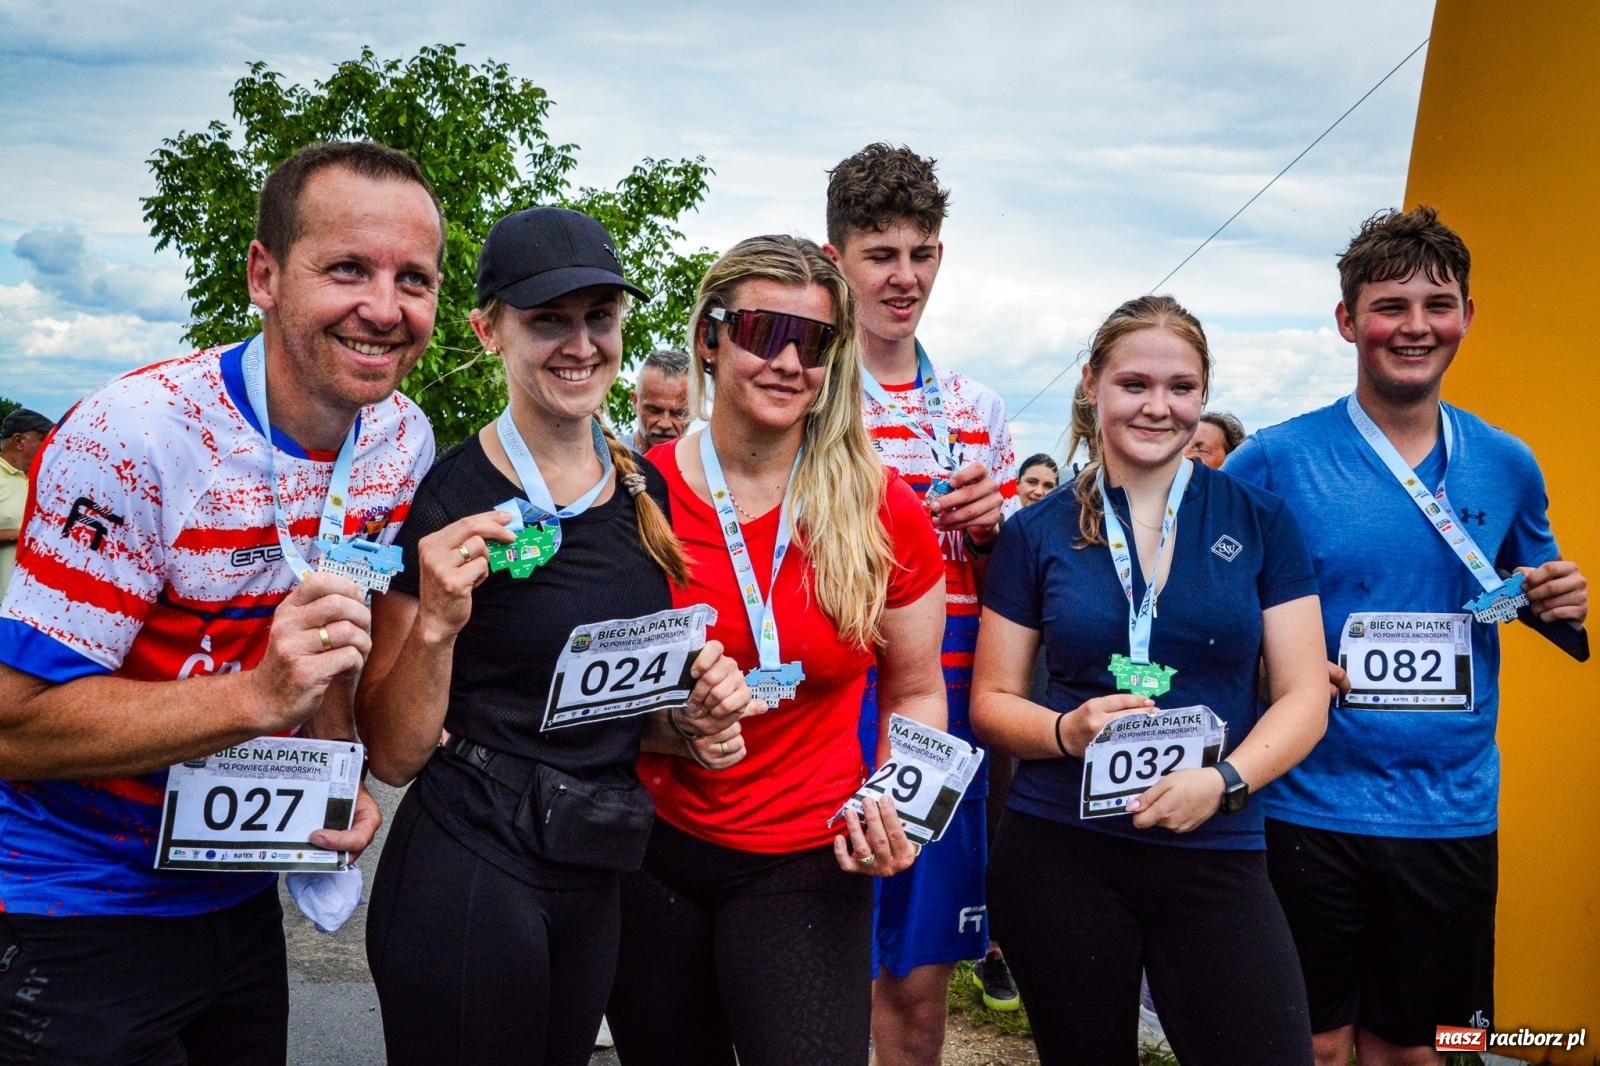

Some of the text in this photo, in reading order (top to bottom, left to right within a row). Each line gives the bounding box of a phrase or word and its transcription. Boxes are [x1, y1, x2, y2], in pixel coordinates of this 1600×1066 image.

[598, 629, 626, 640] BIEG
[629, 625, 645, 637] NA
[648, 616, 690, 632] PIĄTKĘ
[1371, 621, 1394, 629] BIEG
[1397, 621, 1412, 629] NA
[1416, 621, 1451, 632] PIĄTKĘ
[581, 652, 668, 696] 024
[1364, 649, 1442, 682] 082
[1117, 714, 1201, 732] BIEG NA PIĄTKĘ
[891, 723, 953, 758] NA PIĄTKĘ
[232, 763, 268, 772] POWIECIE
[253, 749, 273, 760] NA
[277, 750, 328, 766] PIĄTKĘ
[1109, 745, 1185, 784] 032
[864, 763, 922, 803] 29
[203, 785, 304, 832] 027
